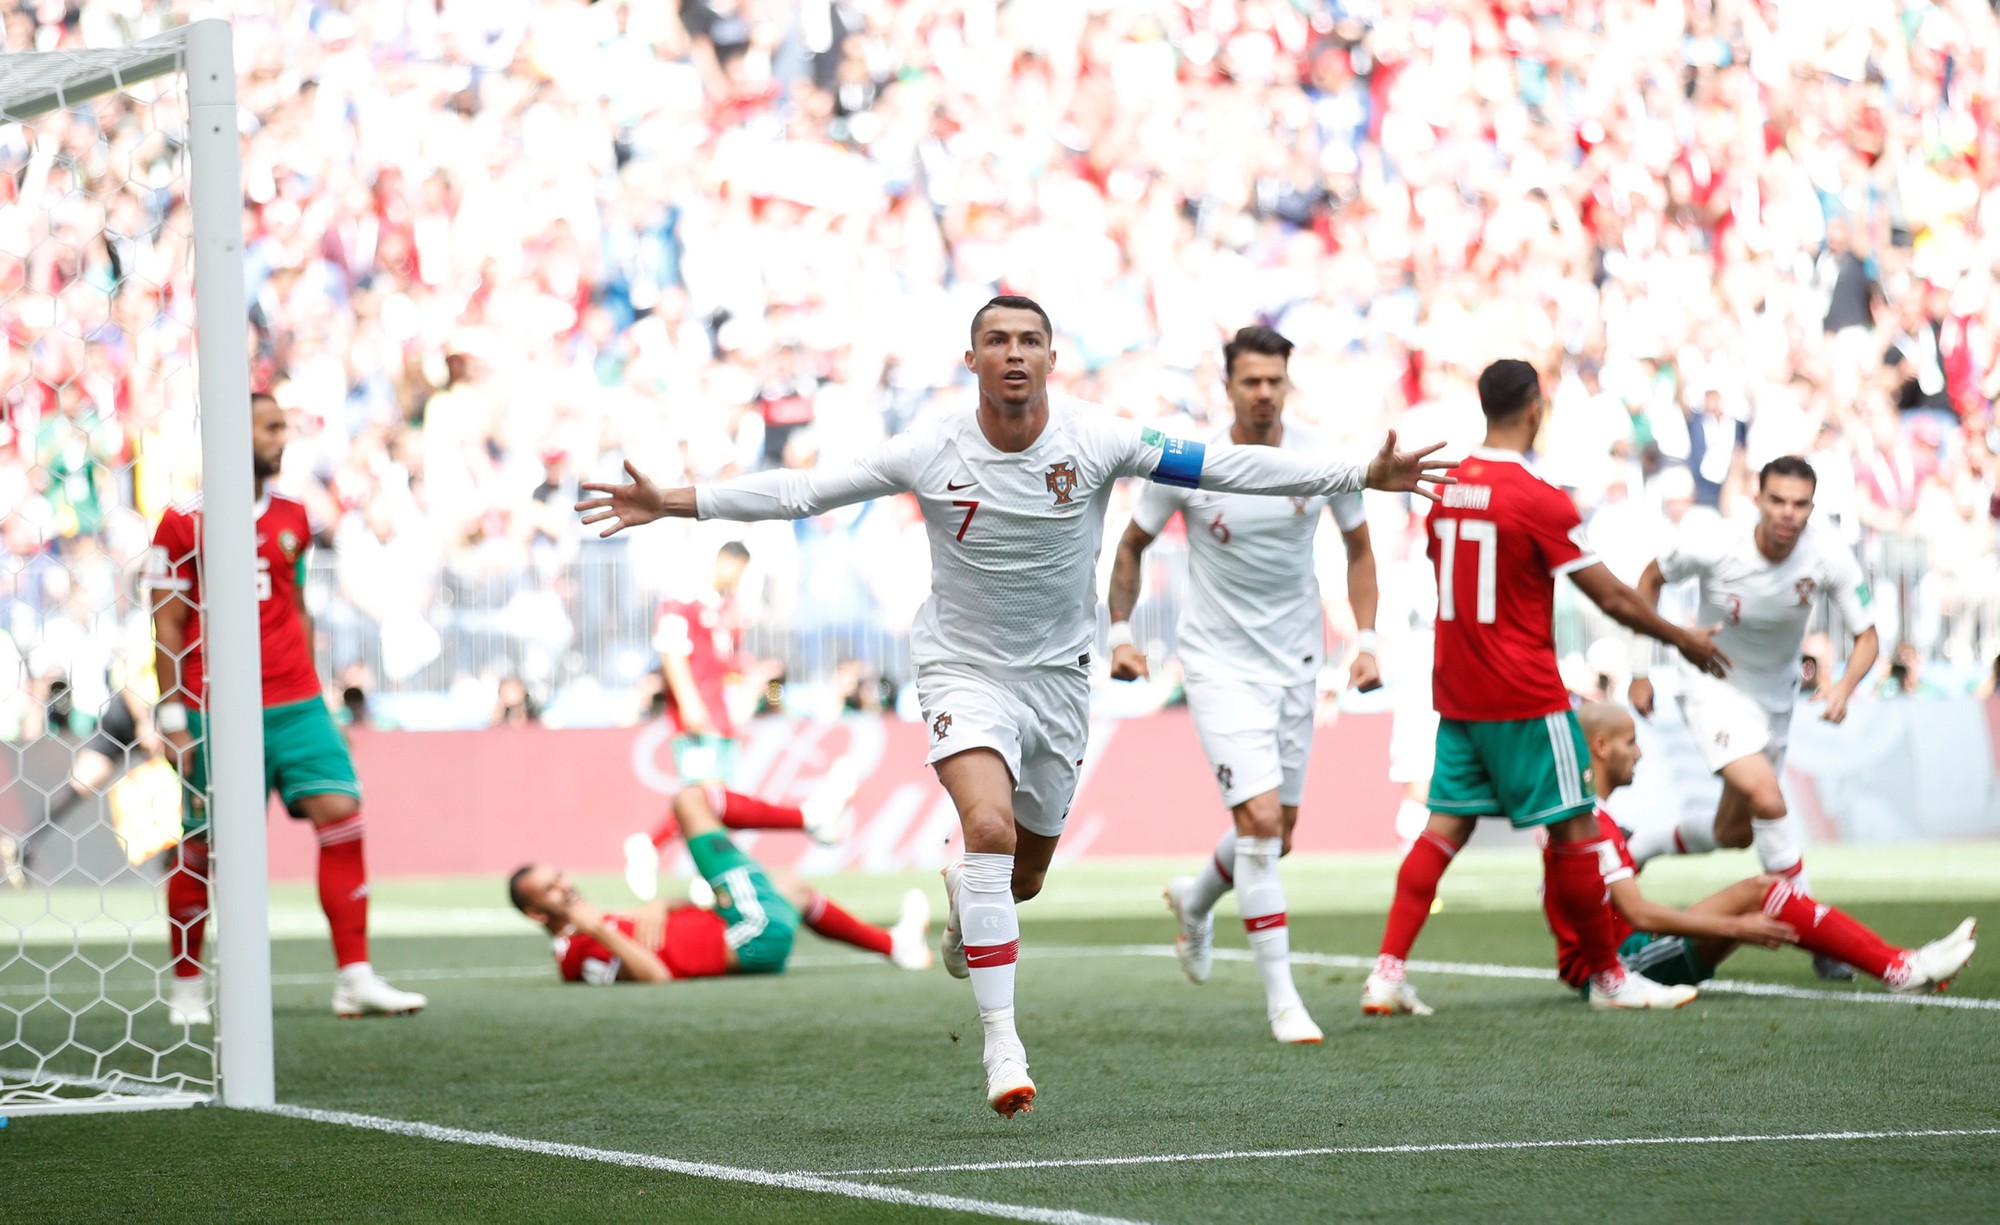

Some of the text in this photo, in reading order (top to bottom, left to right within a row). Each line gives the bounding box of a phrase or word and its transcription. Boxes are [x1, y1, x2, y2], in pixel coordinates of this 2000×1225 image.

[952, 500, 980, 543] 7
[1210, 512, 1231, 545] 6
[1433, 518, 1498, 624] 17
